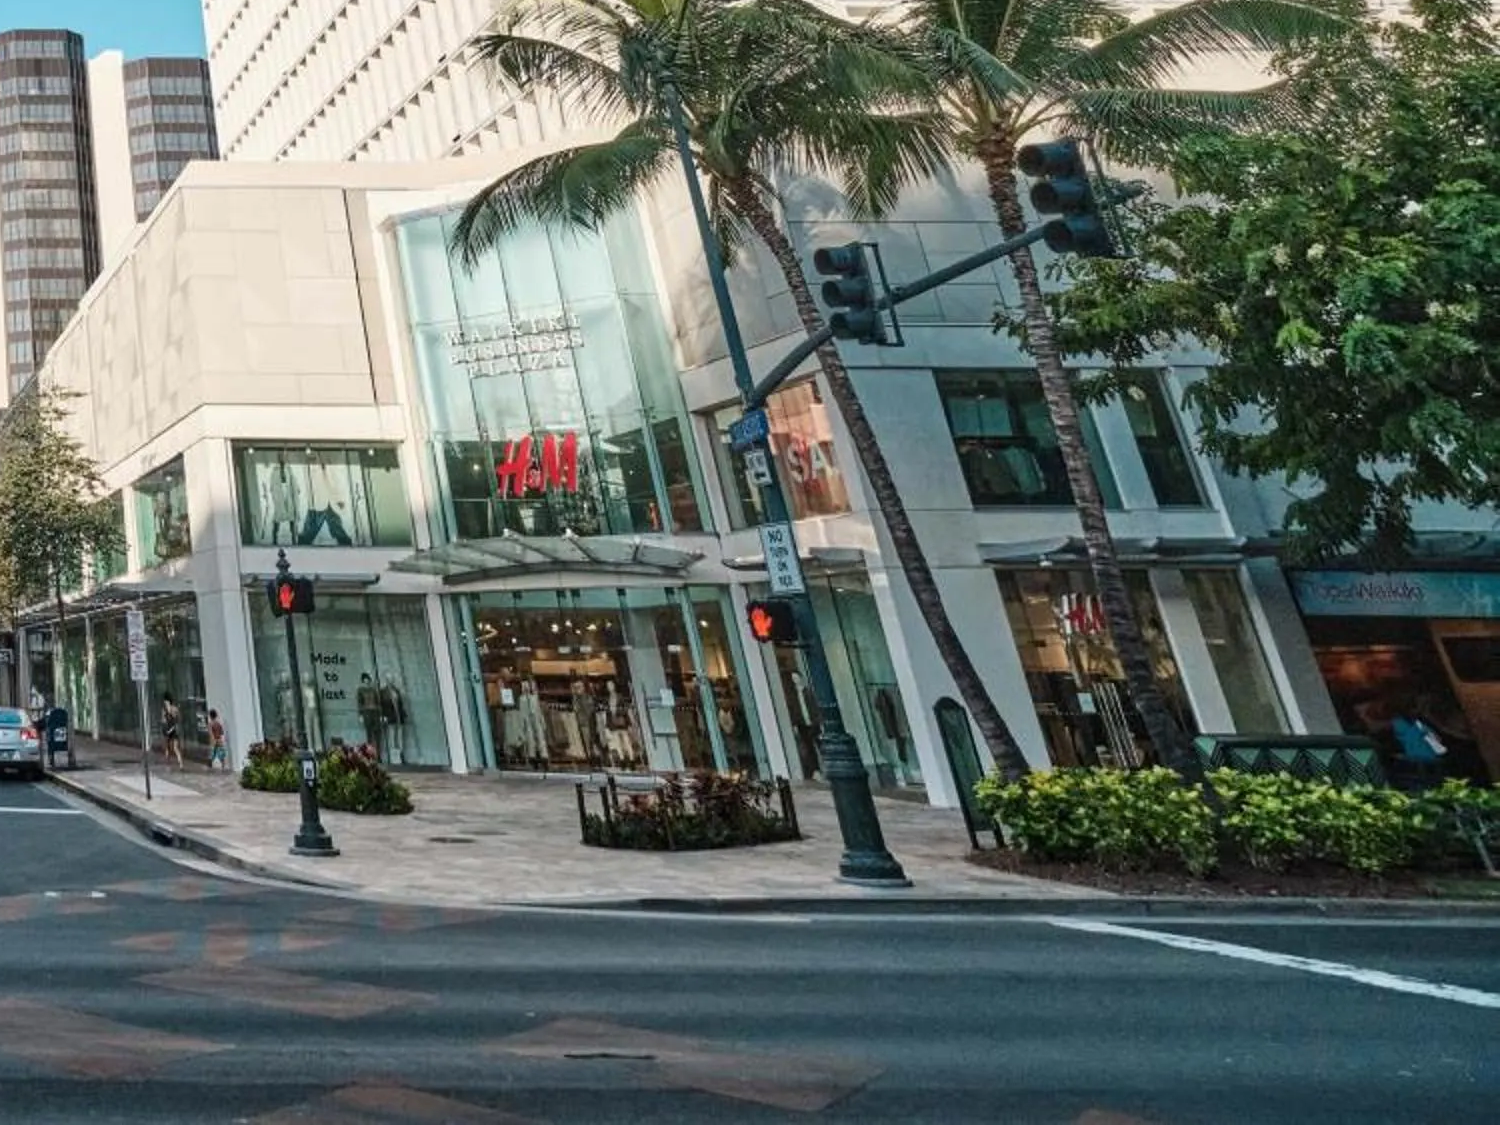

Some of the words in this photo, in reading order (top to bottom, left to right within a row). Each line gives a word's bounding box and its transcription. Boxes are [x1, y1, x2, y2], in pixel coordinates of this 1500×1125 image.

[496, 428, 580, 499] H&M
[767, 530, 783, 543] NO
[310, 652, 347, 665] Made
[323, 671, 339, 682] to
[321, 688, 347, 700] last
